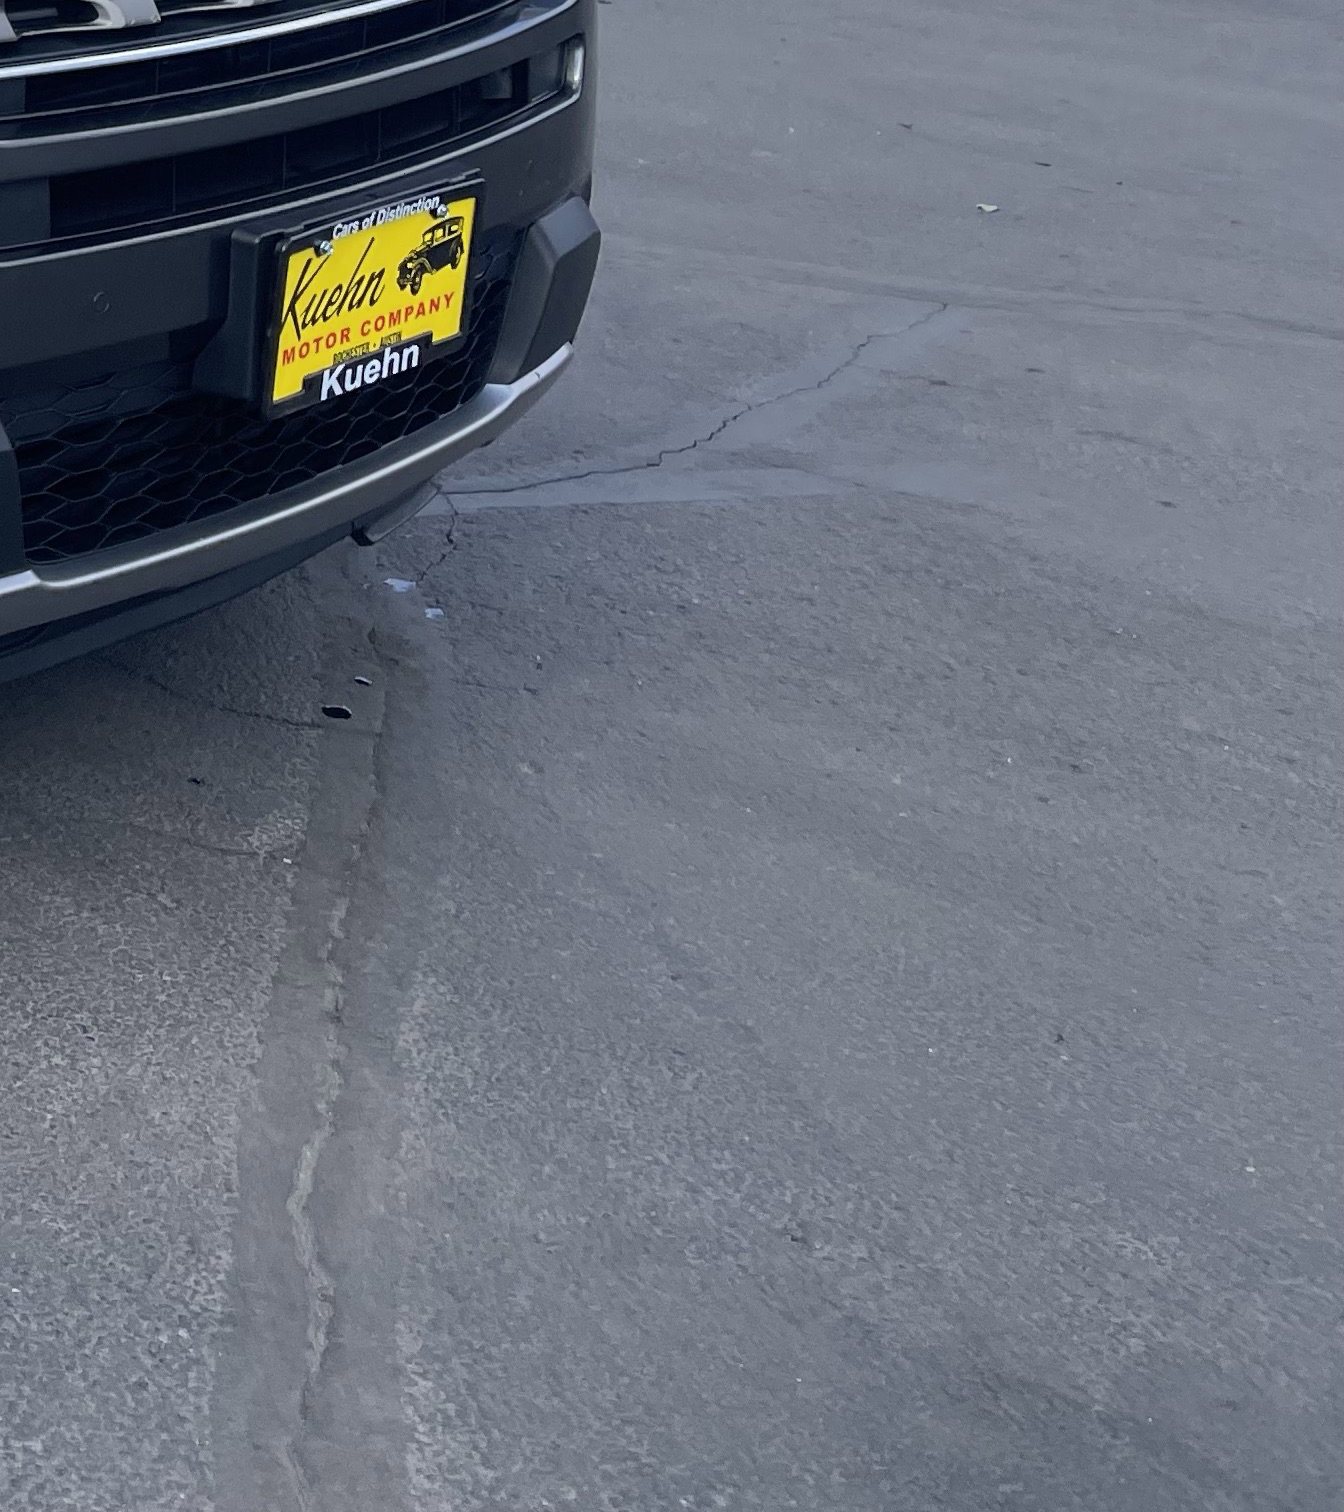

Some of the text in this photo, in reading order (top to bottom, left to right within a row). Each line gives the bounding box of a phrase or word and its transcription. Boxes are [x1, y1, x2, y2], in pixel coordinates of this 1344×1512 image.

[332, 194, 441, 241] Cars of Distinction
[280, 236, 386, 342] Kuehn
[282, 291, 455, 367] MOTOR COMPANY
[320, 343, 420, 401] Kuehn
